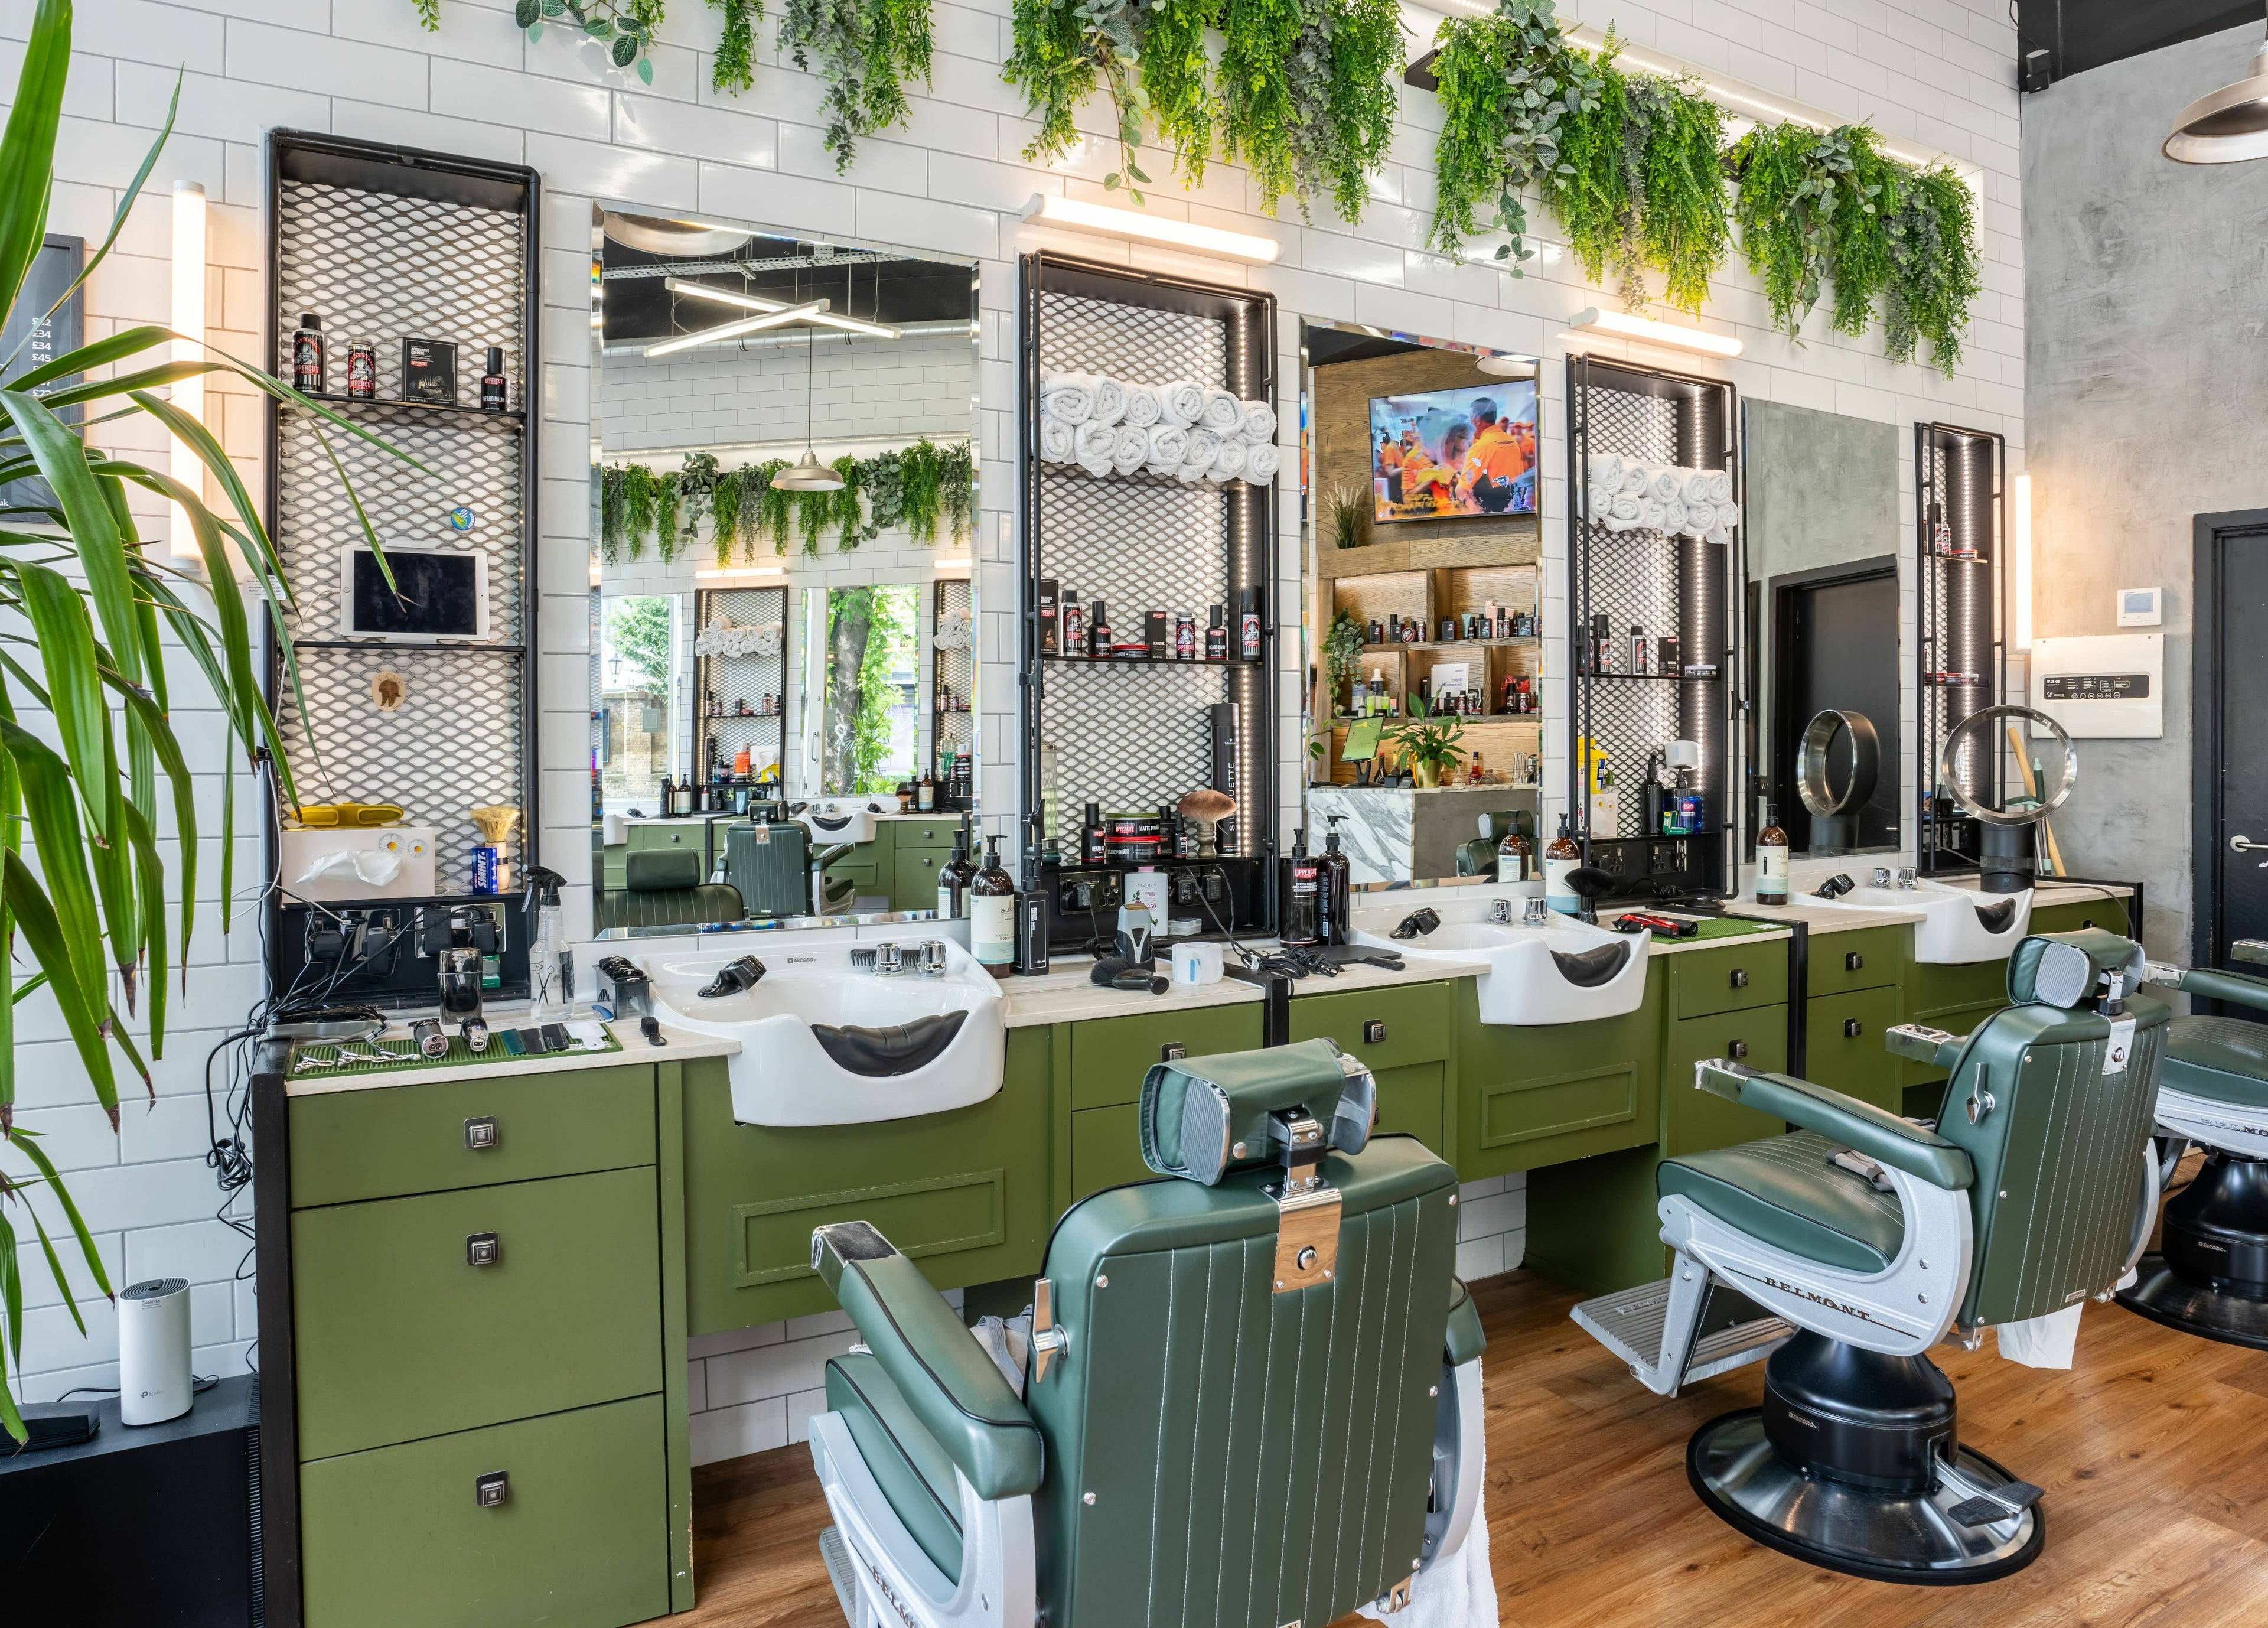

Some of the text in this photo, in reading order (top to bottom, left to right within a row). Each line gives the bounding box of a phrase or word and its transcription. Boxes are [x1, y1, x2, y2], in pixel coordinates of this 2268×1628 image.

[32, 330, 51, 338] £34
[32, 341, 51, 350] £34
[32, 353, 51, 362] £45
[295, 365, 319, 373] PPERCUT
[349, 380, 373, 389] UPPERCUT
[478, 853, 487, 889] SMINT
[1765, 1277, 1869, 1321] BELMONT
